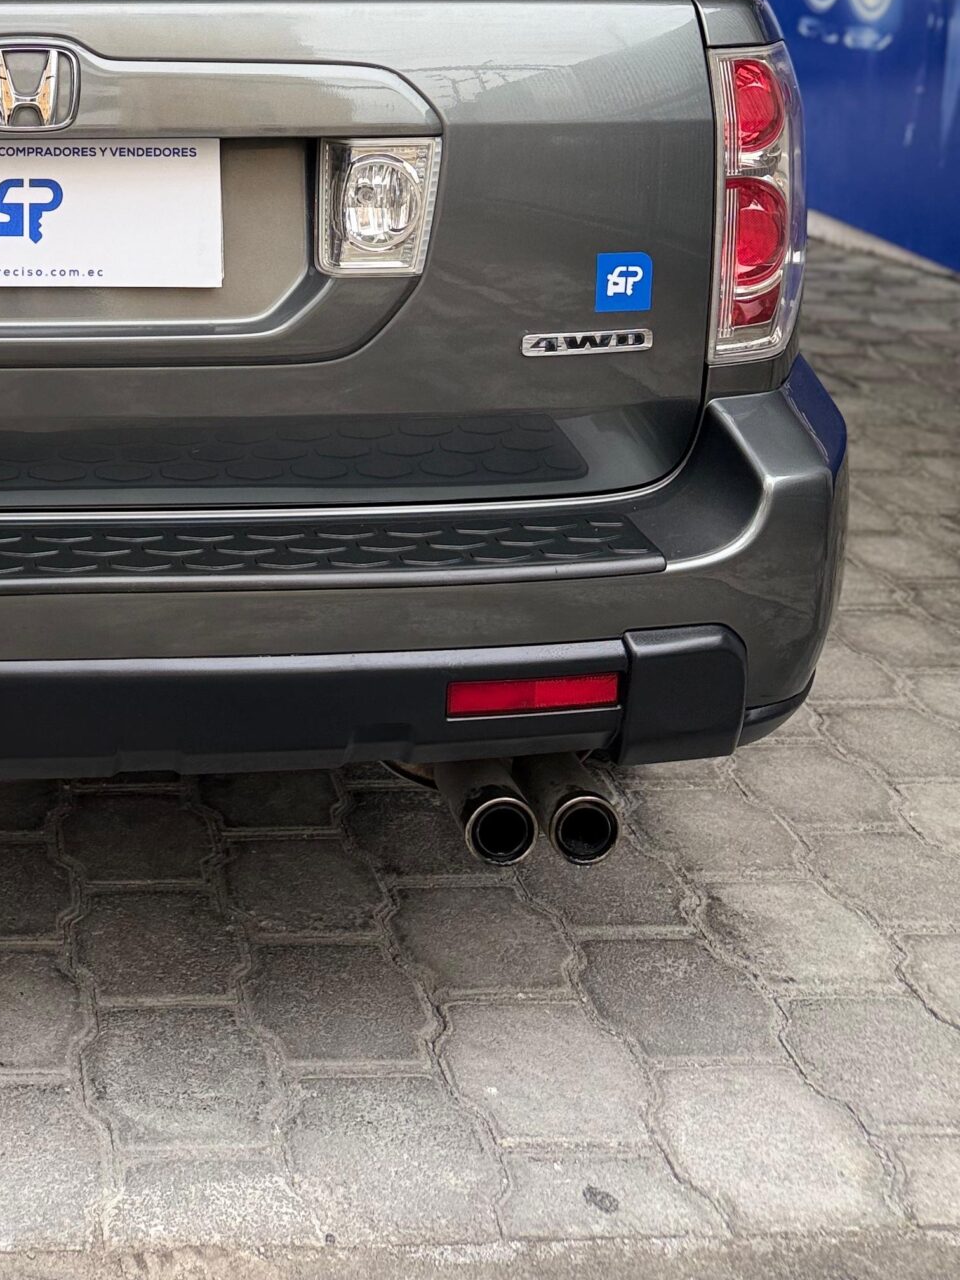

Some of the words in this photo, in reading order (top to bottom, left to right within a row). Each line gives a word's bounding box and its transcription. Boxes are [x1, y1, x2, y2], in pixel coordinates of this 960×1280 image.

[100, 146, 108, 158] Y
[110, 146, 197, 158] VENDEDORES
[530, 331, 646, 353] 4WD
